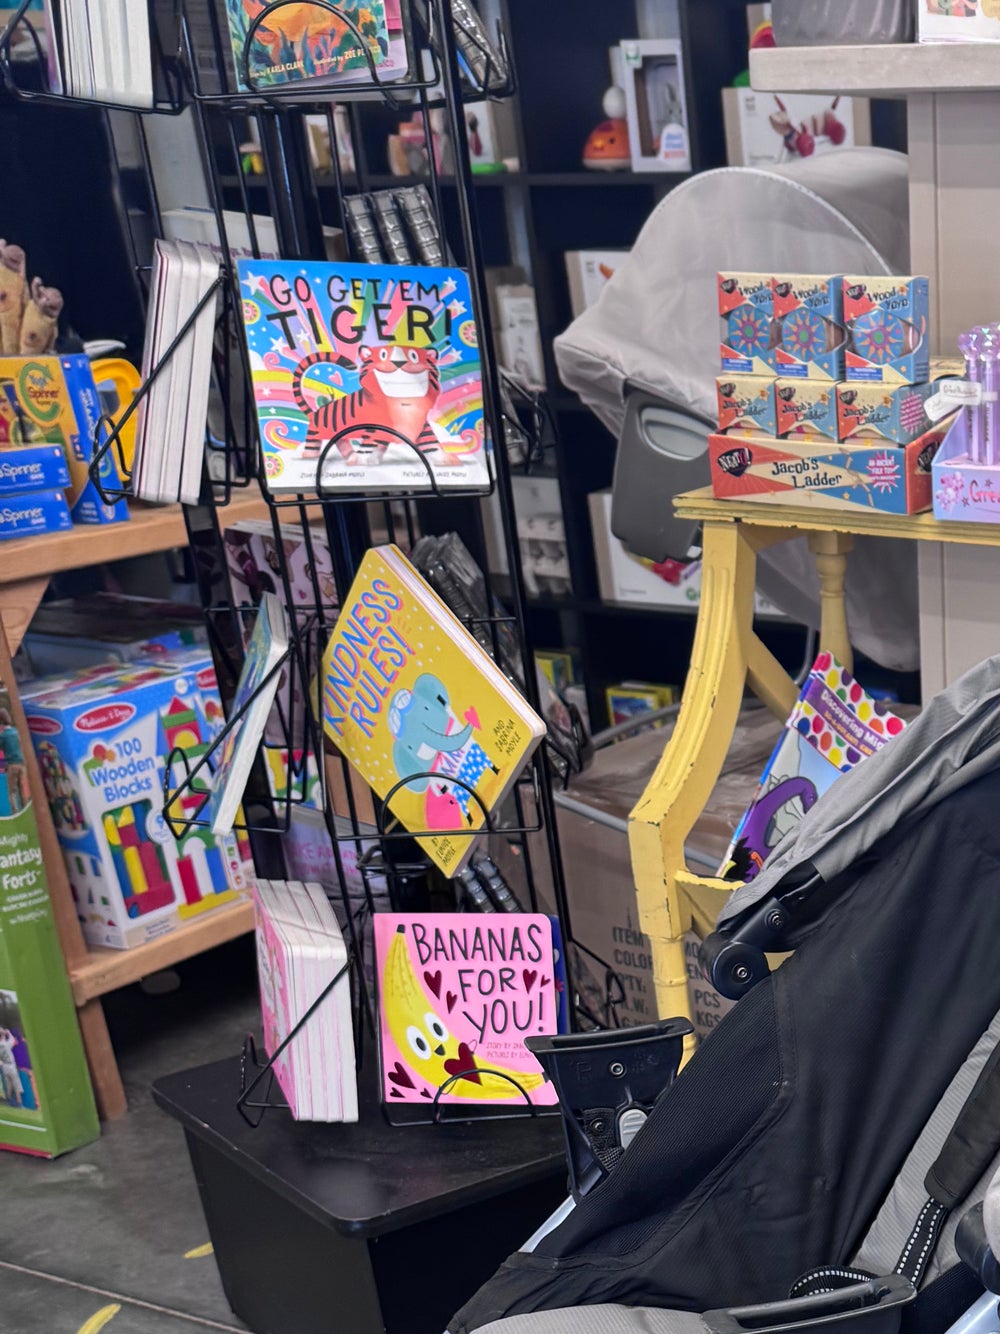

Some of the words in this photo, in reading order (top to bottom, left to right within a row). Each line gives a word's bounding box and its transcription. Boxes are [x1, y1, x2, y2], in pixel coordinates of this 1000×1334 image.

[270, 274, 311, 306] GO
[327, 275, 382, 303] GET
[266, 303, 452, 350] TIGER!
[772, 458, 819, 476] Jacob's
[792, 474, 842, 489] Ladder
[323, 578, 403, 737] KINDNESS
[349, 625, 416, 739] RULES!
[493, 719, 505, 736] AND
[820, 689, 864, 739] Discovering
[116, 737, 142, 758] 100
[495, 719, 518, 752] SABRINA
[506, 733, 521, 756] MOYLE
[91, 757, 155, 786] Wooden
[103, 776, 153, 803] Blocks
[412, 923, 543, 966] BANANAS
[458, 967, 518, 1002] FOR
[694, 989, 721, 1008] PCS
[462, 992, 545, 1044] YOU!
